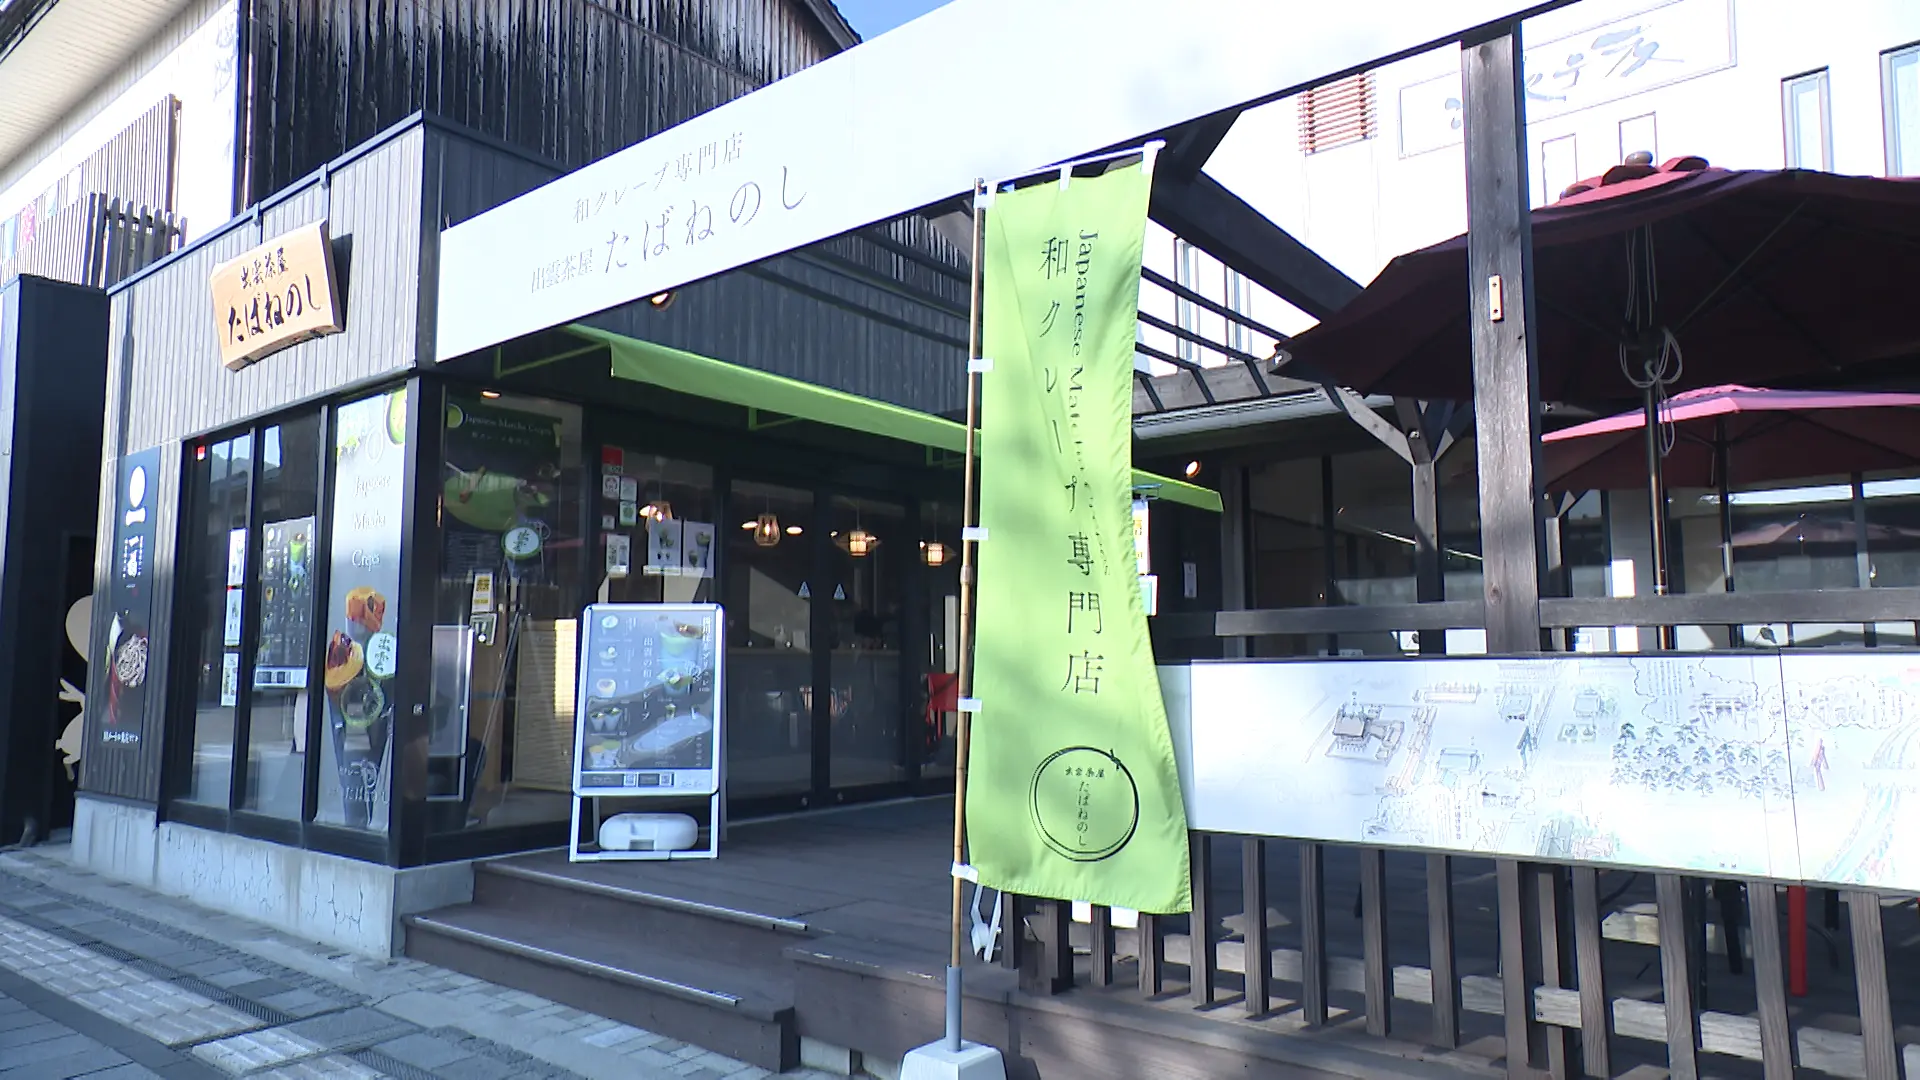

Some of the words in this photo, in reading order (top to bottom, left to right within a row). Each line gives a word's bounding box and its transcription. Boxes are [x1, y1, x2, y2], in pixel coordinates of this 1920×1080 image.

[573, 131, 744, 224] 和クレープ専門店
[241, 247, 289, 290] 出雲茶屋
[531, 247, 594, 293] 出雲茶屋
[604, 165, 808, 273] たばねのし
[228, 274, 321, 345] たばねのし
[1071, 229, 1099, 358] Japanese
[1077, 781, 1090, 847] たばねのし
